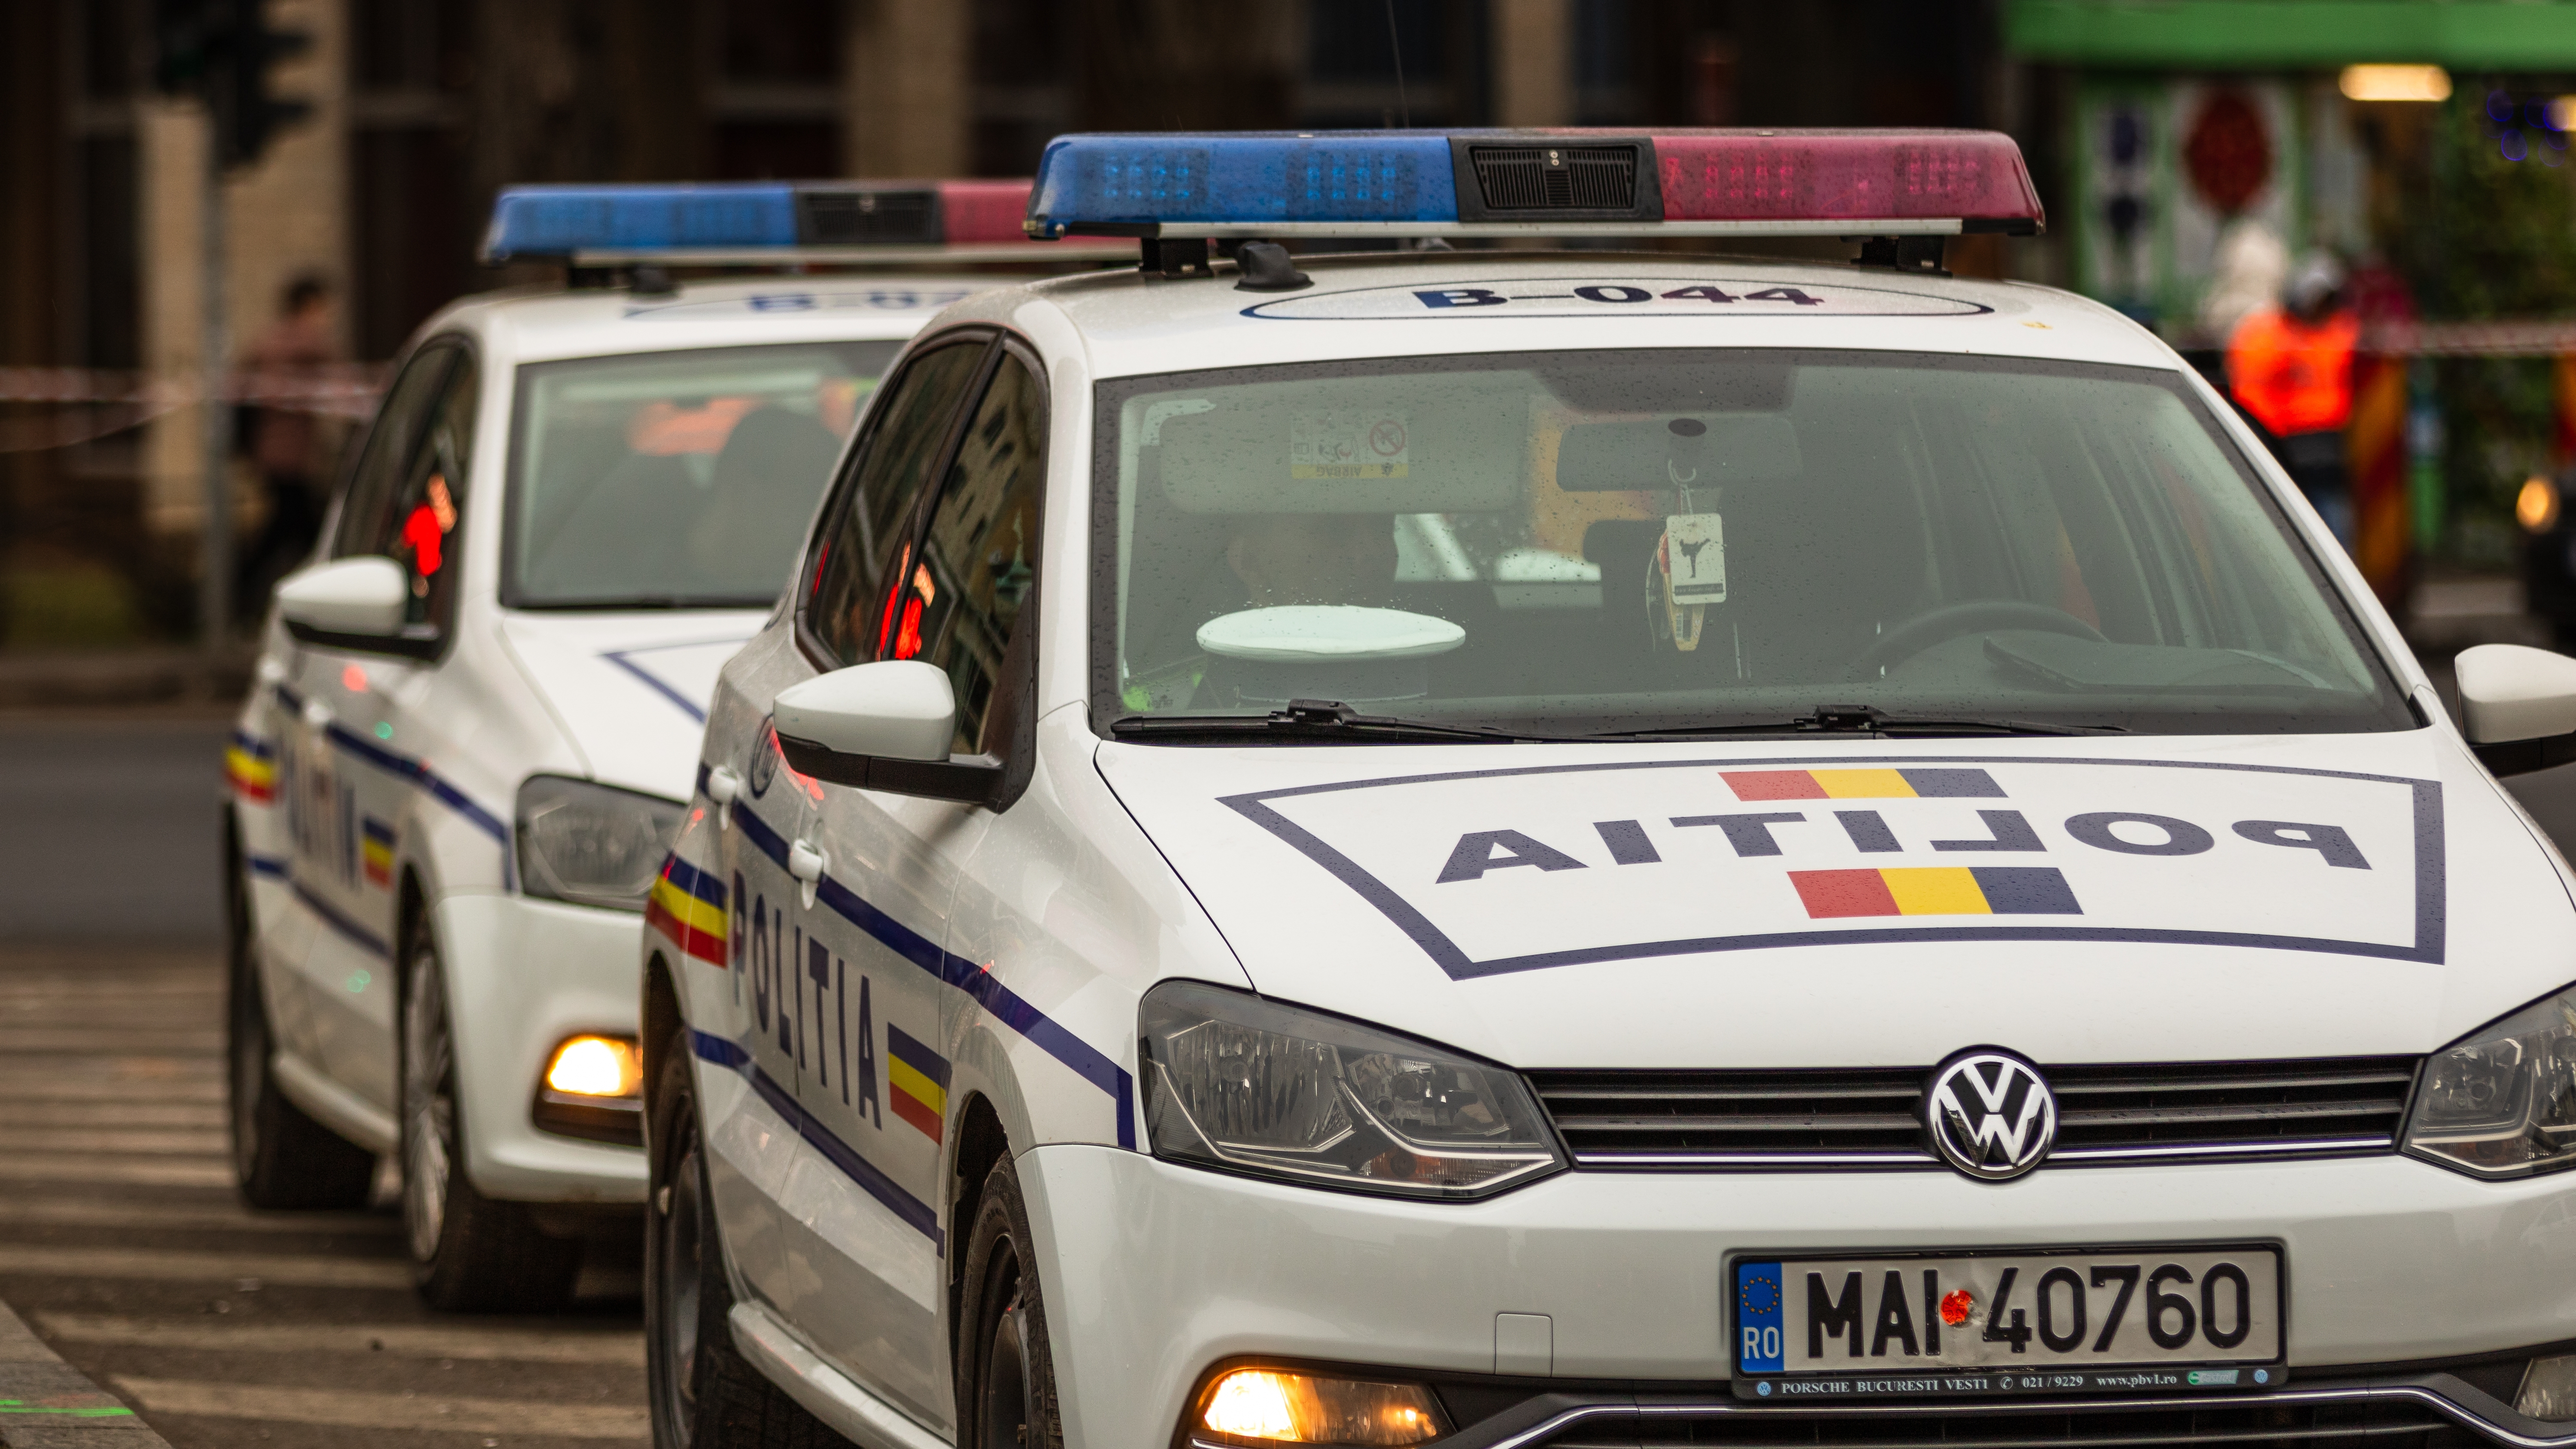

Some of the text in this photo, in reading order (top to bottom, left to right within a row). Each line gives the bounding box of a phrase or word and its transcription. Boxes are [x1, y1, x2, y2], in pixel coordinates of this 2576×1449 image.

[1412, 286, 1824, 309] B-044
[1315, 465, 1362, 477] AIRBAG
[731, 867, 882, 1131] POLITIA
[1807, 1262, 2251, 1358] MAI 40760
[1744, 1326, 1780, 1359] RO
[1781, 1382, 1850, 1394] PORSCHE
[1857, 1379, 1940, 1392] BUCURESTI
[2022, 1376, 2043, 1388] 021
[2054, 1376, 2084, 1387] 9229
[2097, 1374, 2178, 1388] www.pbv1.ro
